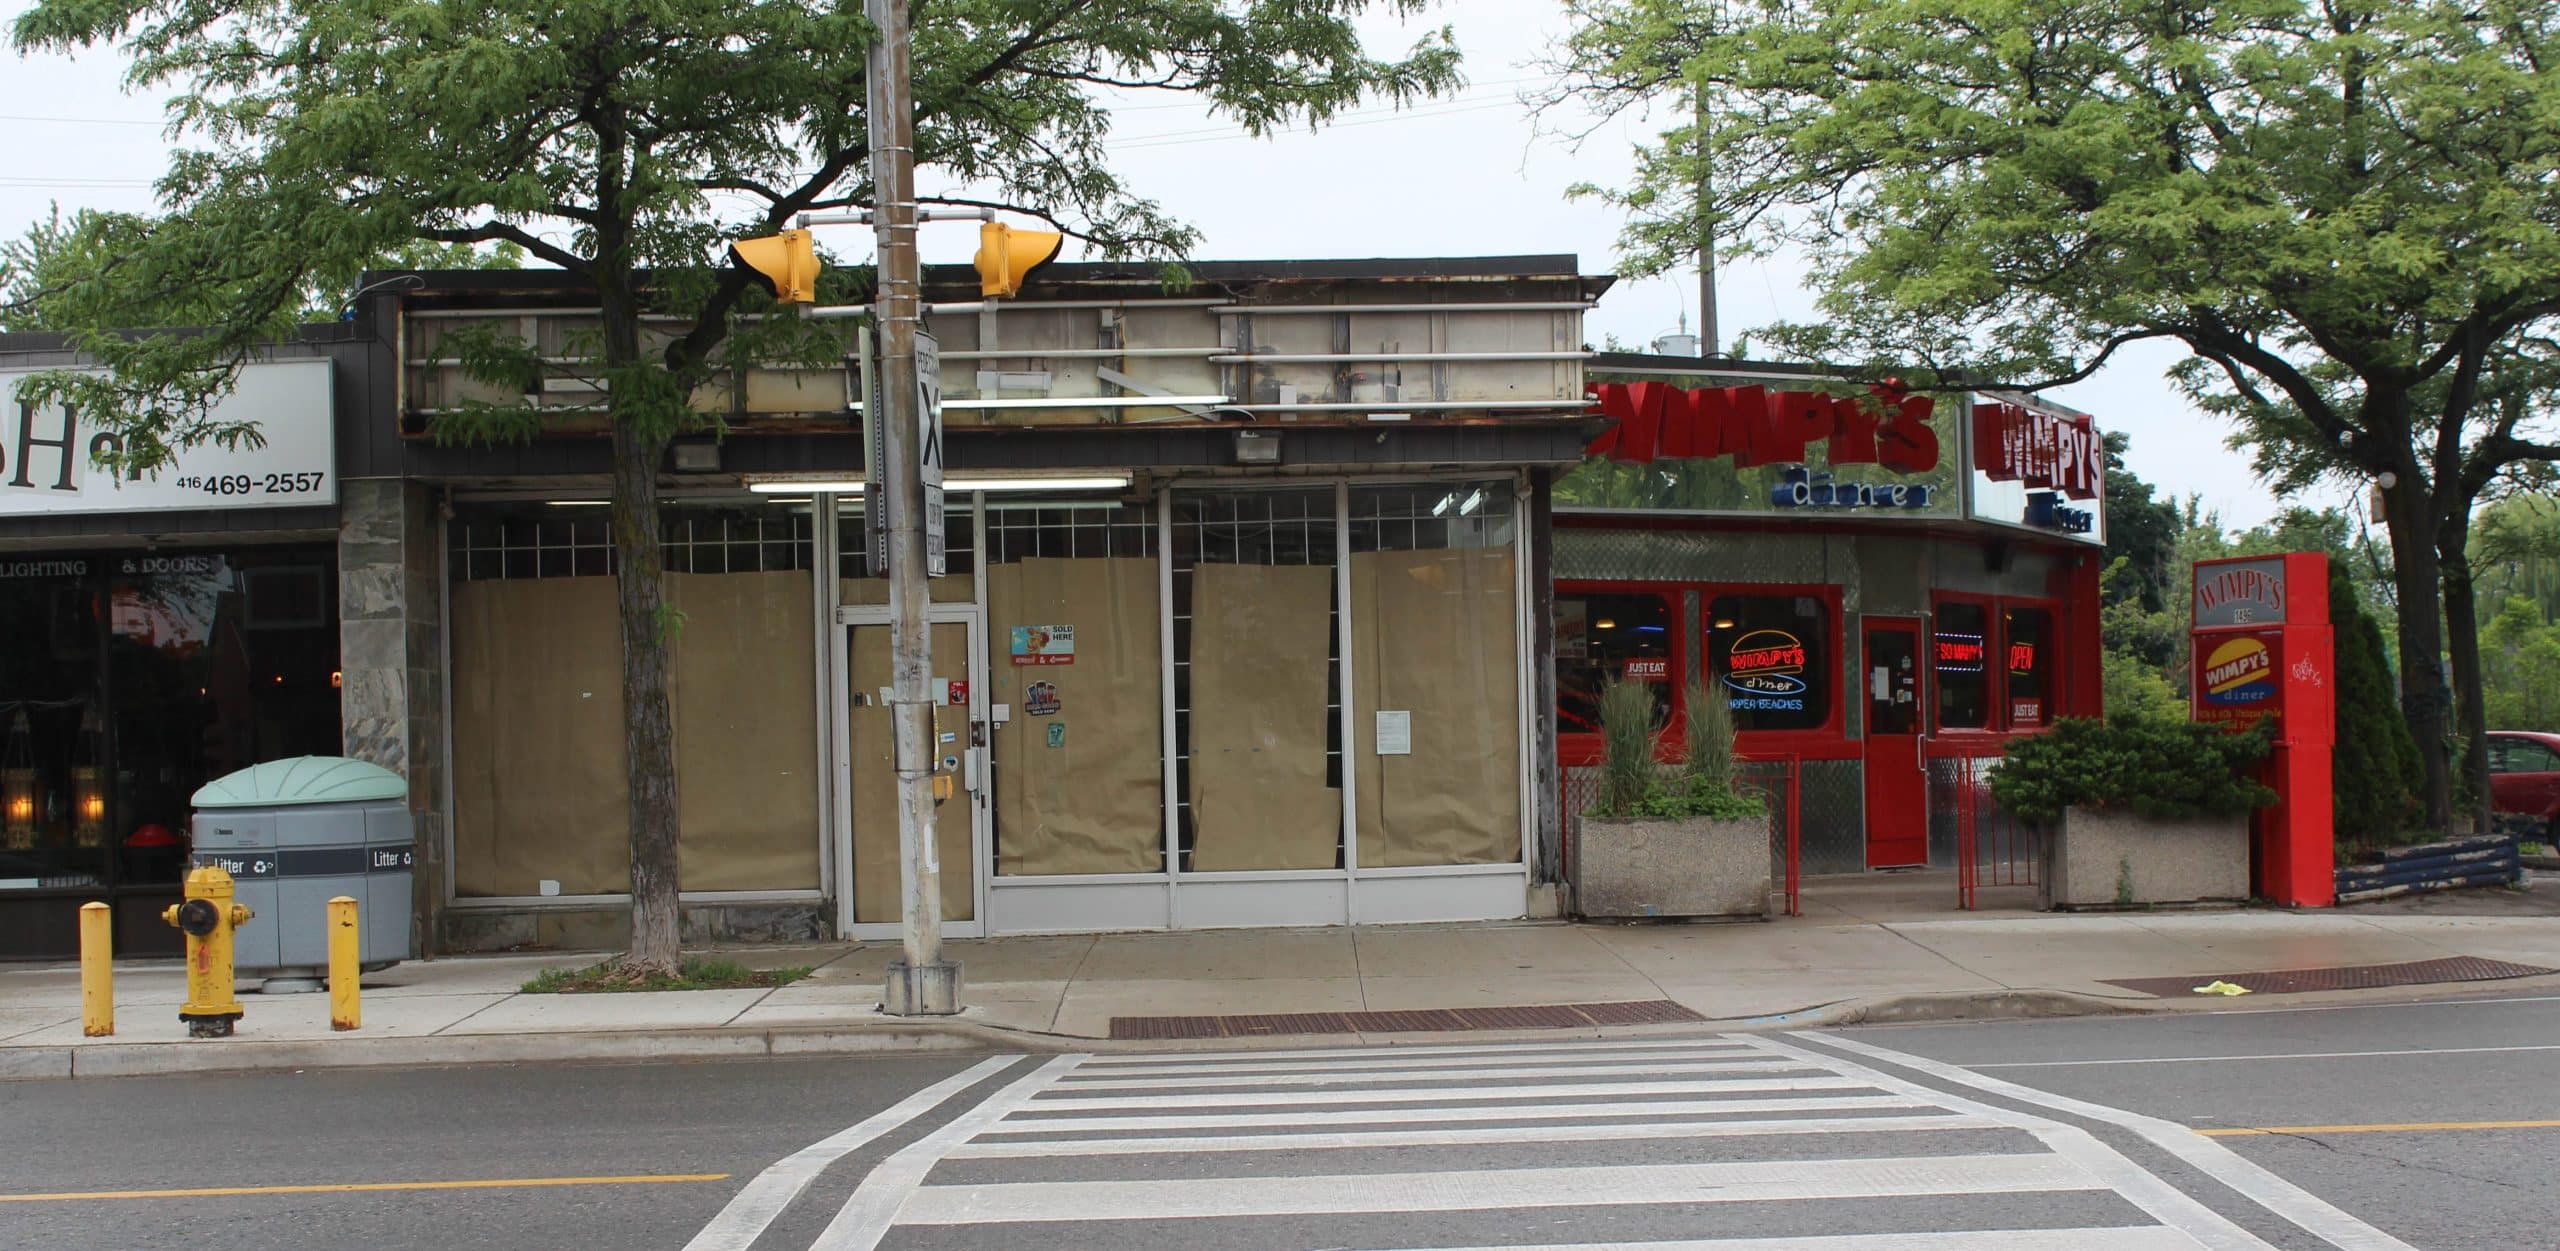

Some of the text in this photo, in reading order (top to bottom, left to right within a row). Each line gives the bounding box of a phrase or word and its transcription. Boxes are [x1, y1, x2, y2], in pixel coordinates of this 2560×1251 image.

[920, 381, 942, 470] X
[177, 472, 325, 496] 416 469-2557
[1790, 467, 1938, 507] diner
[0, 557, 210, 578] LIGHTING & DOORS
[2200, 569, 2284, 615] WIMPY'S
[1052, 625, 1073, 633] SOLD
[1052, 633, 1073, 641] HERE
[1730, 645, 1805, 670] WIMPY'S
[2009, 645, 2033, 670] OPEN
[1627, 662, 1666, 673] JUST EAT
[2206, 649, 2270, 686] WIMPY'S
[1746, 677, 1793, 692] diner
[2223, 688, 2266, 700] diner
[1758, 698, 1803, 710] BEACHES
[2014, 704, 2028, 717] JUST
[214, 858, 244, 874] Litter
[374, 850, 399, 867] Litter
